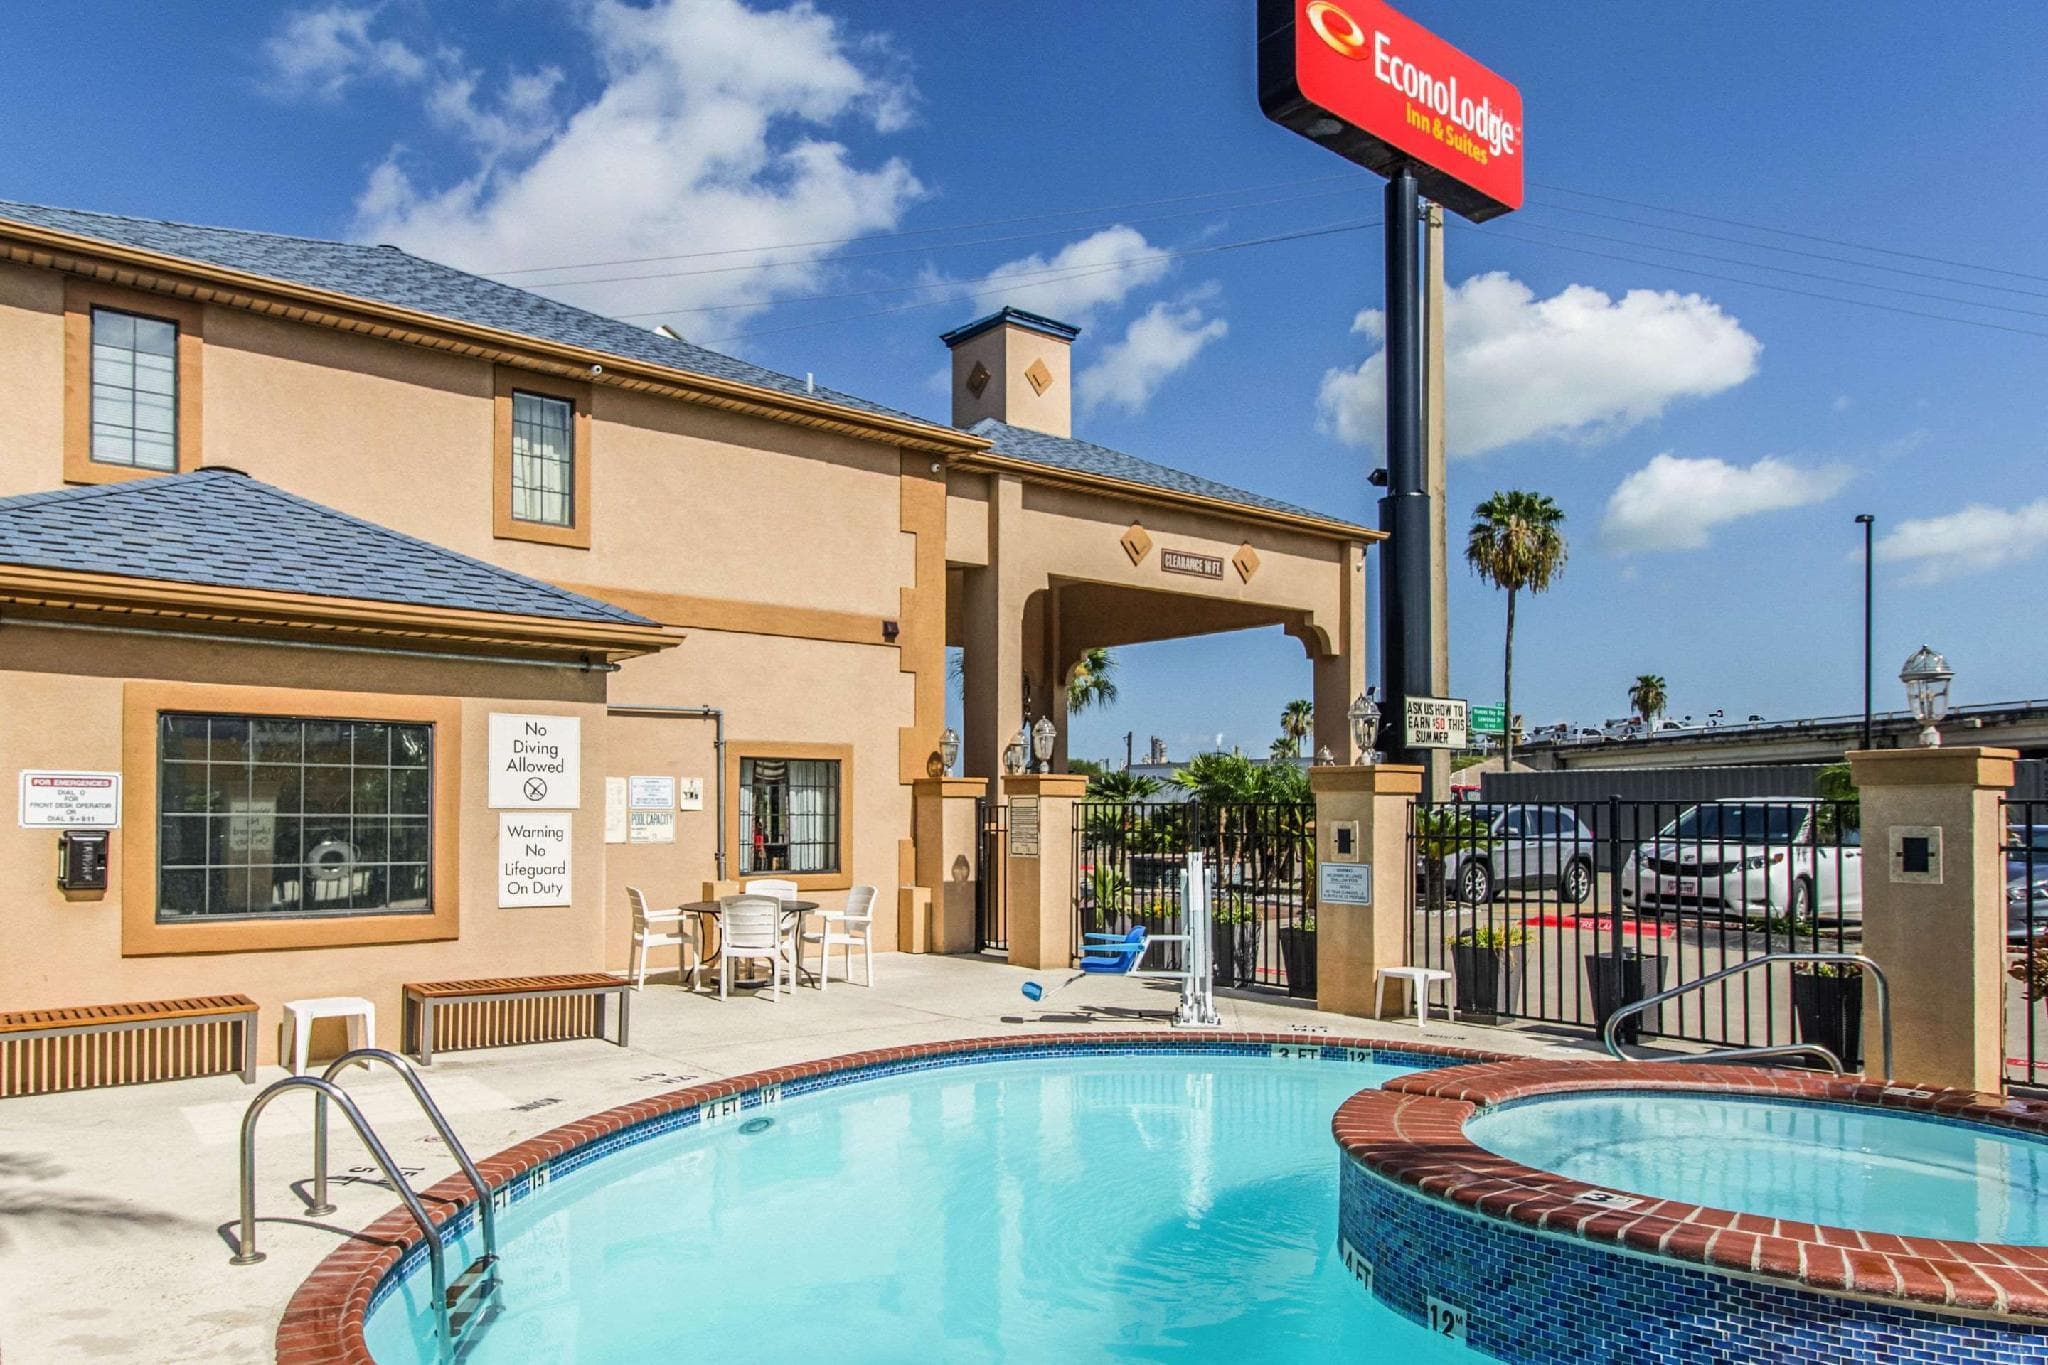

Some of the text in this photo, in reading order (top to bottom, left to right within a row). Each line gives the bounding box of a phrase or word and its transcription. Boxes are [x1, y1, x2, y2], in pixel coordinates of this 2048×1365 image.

[1406, 101, 1488, 165] Inn & Suites
[1165, 553, 1203, 572] CLEARANCE
[1407, 701, 1463, 717] ASK US HOW TO
[525, 722, 547, 736] No
[1408, 716, 1431, 729] EARN
[1448, 718, 1465, 731] THIS
[1415, 730, 1449, 744] SUMMER
[513, 740, 559, 759] Diving
[505, 758, 564, 773] Allowed
[507, 825, 564, 841] Warning
[525, 844, 546, 857] No
[505, 860, 566, 879] Lifeguard
[507, 881, 563, 897] On Duty
[1297, 1048, 1318, 1060] FT
[763, 1087, 775, 1104] 12
[707, 1097, 738, 1119] 4 FT
[531, 1166, 545, 1190] 15
[493, 1185, 509, 1214] FT
[1356, 1259, 1371, 1291] FT
